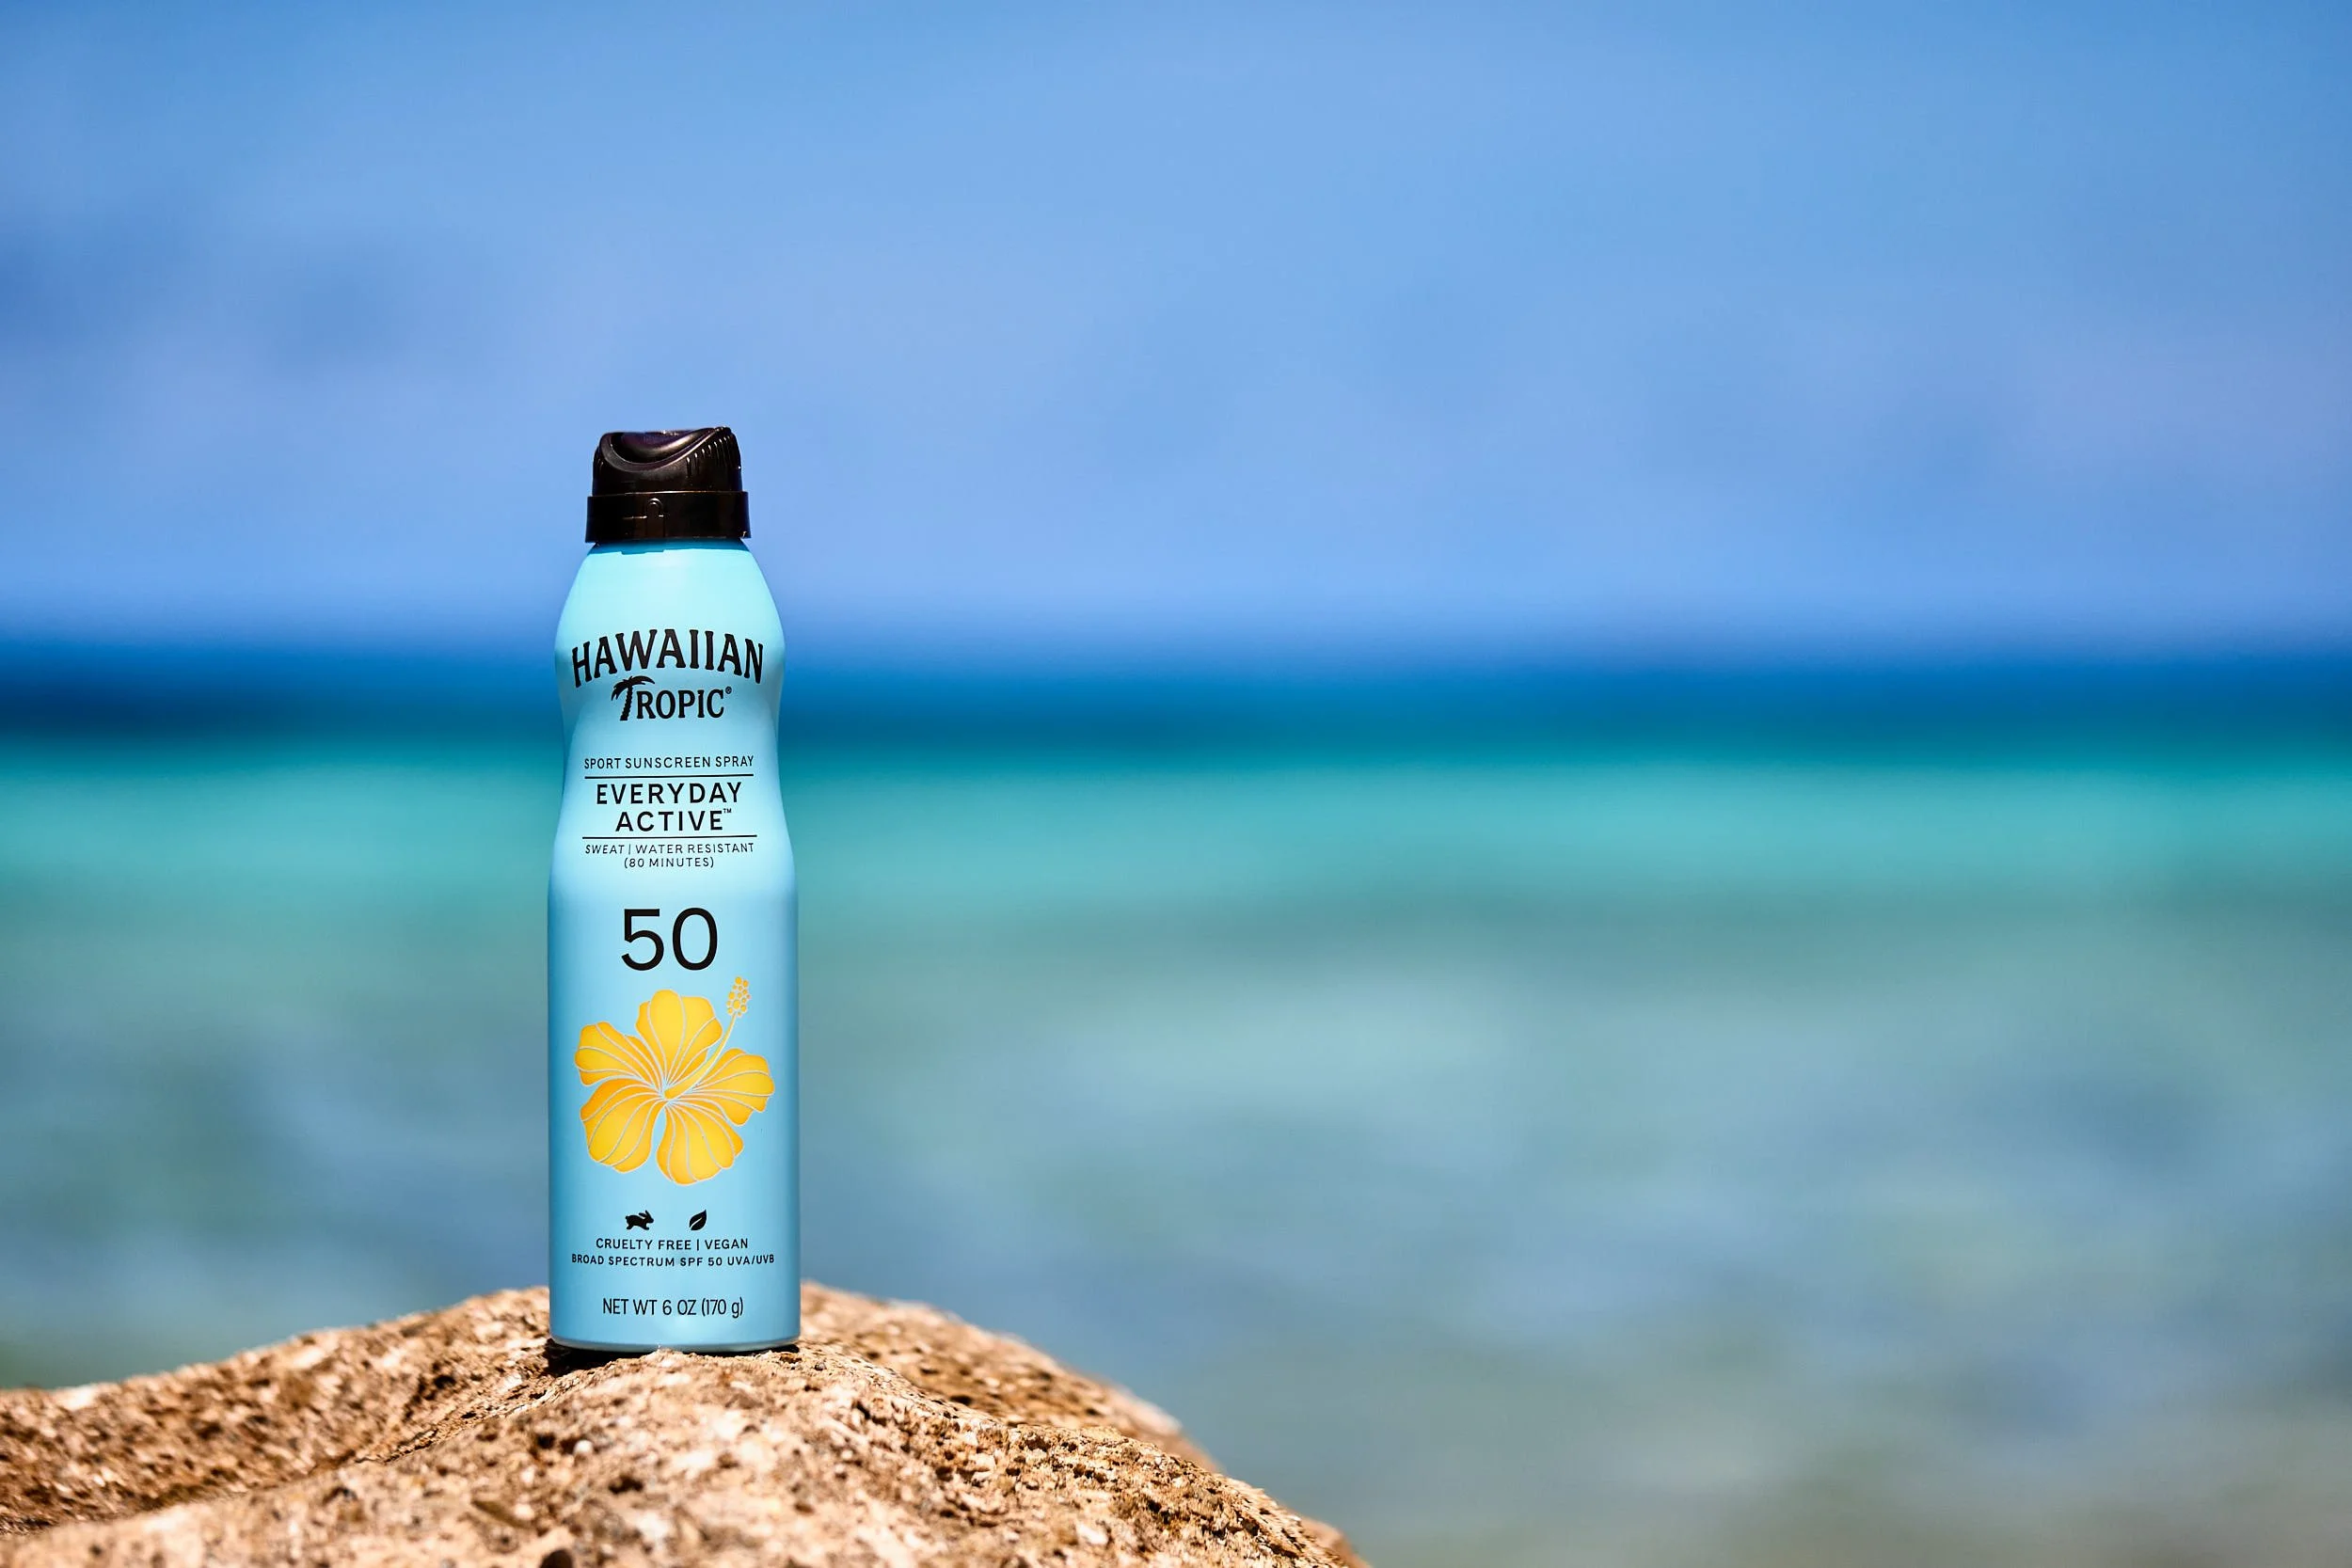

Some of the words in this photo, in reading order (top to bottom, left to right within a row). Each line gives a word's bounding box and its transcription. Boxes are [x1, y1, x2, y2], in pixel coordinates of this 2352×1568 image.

[571, 628, 764, 689] HAWAIIAN
[583, 757, 622, 769] SPORT
[625, 756, 711, 769] SUNSCREEN
[715, 754, 755, 768] SPRAY
[596, 781, 742, 805] EVERYDAY
[584, 844, 625, 855] SWEAT
[635, 844, 683, 854] WATER
[687, 842, 754, 854] RESISTANT
[624, 857, 644, 869] (80
[648, 856, 714, 868] MINUTES)
[621, 907, 718, 972] 50
[596, 1237, 653, 1250] CRUELTY
[658, 1239, 691, 1251] FREE
[704, 1237, 748, 1250] VEGAN
[571, 1253, 605, 1265] BROAD
[608, 1256, 675, 1267] SPECTRUM
[679, 1257, 704, 1267] SPF
[707, 1257, 723, 1267] 50
[727, 1253, 775, 1266] UVA/UVB
[602, 1297, 629, 1315] NET
[632, 1298, 658, 1316] WT
[661, 1299, 673, 1316] 6
[676, 1299, 697, 1316] OZ
[701, 1297, 727, 1317] (170
[731, 1296, 744, 1320] g)
